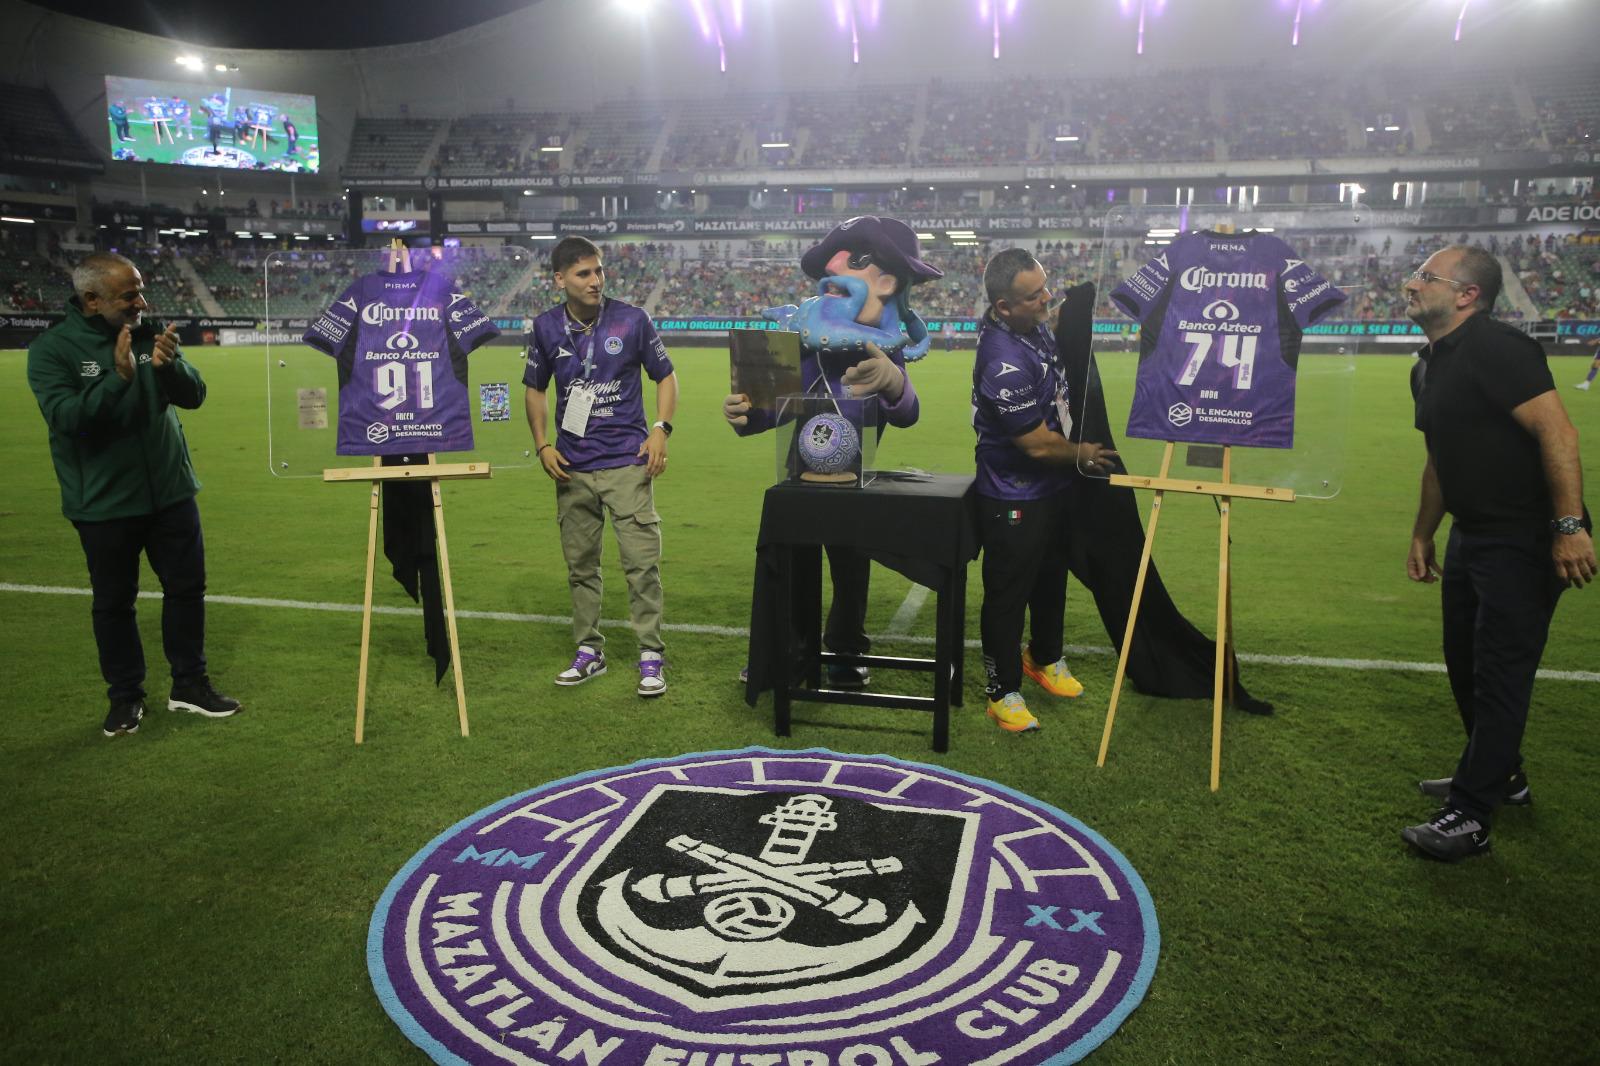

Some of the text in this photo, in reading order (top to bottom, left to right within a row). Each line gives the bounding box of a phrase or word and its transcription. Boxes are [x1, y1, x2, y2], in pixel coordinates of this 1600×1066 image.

[438, 178, 449, 187] EL
[451, 178, 490, 187] ENCANTO
[1179, 265, 1268, 294] Corona
[1295, 279, 1331, 305] Totalplay
[361, 301, 440, 327] Corona
[10, 317, 50, 329] Totalplay
[317, 316, 343, 337] Hilton
[661, 320, 687, 330] GRAN
[689, 320, 732, 330] ORGULLO
[1177, 320, 1263, 334] Banco Azteca
[365, 350, 440, 360] Banco Azteca
[1178, 331, 1258, 390] 74
[375, 360, 434, 411] 91
[1195, 407, 1253, 418] EL ENCANTO
[391, 423, 443, 432] EL ENCANTO
[1198, 416, 1252, 426] DESARROLLOS
[955, 958, 1081, 1040] CLUB
